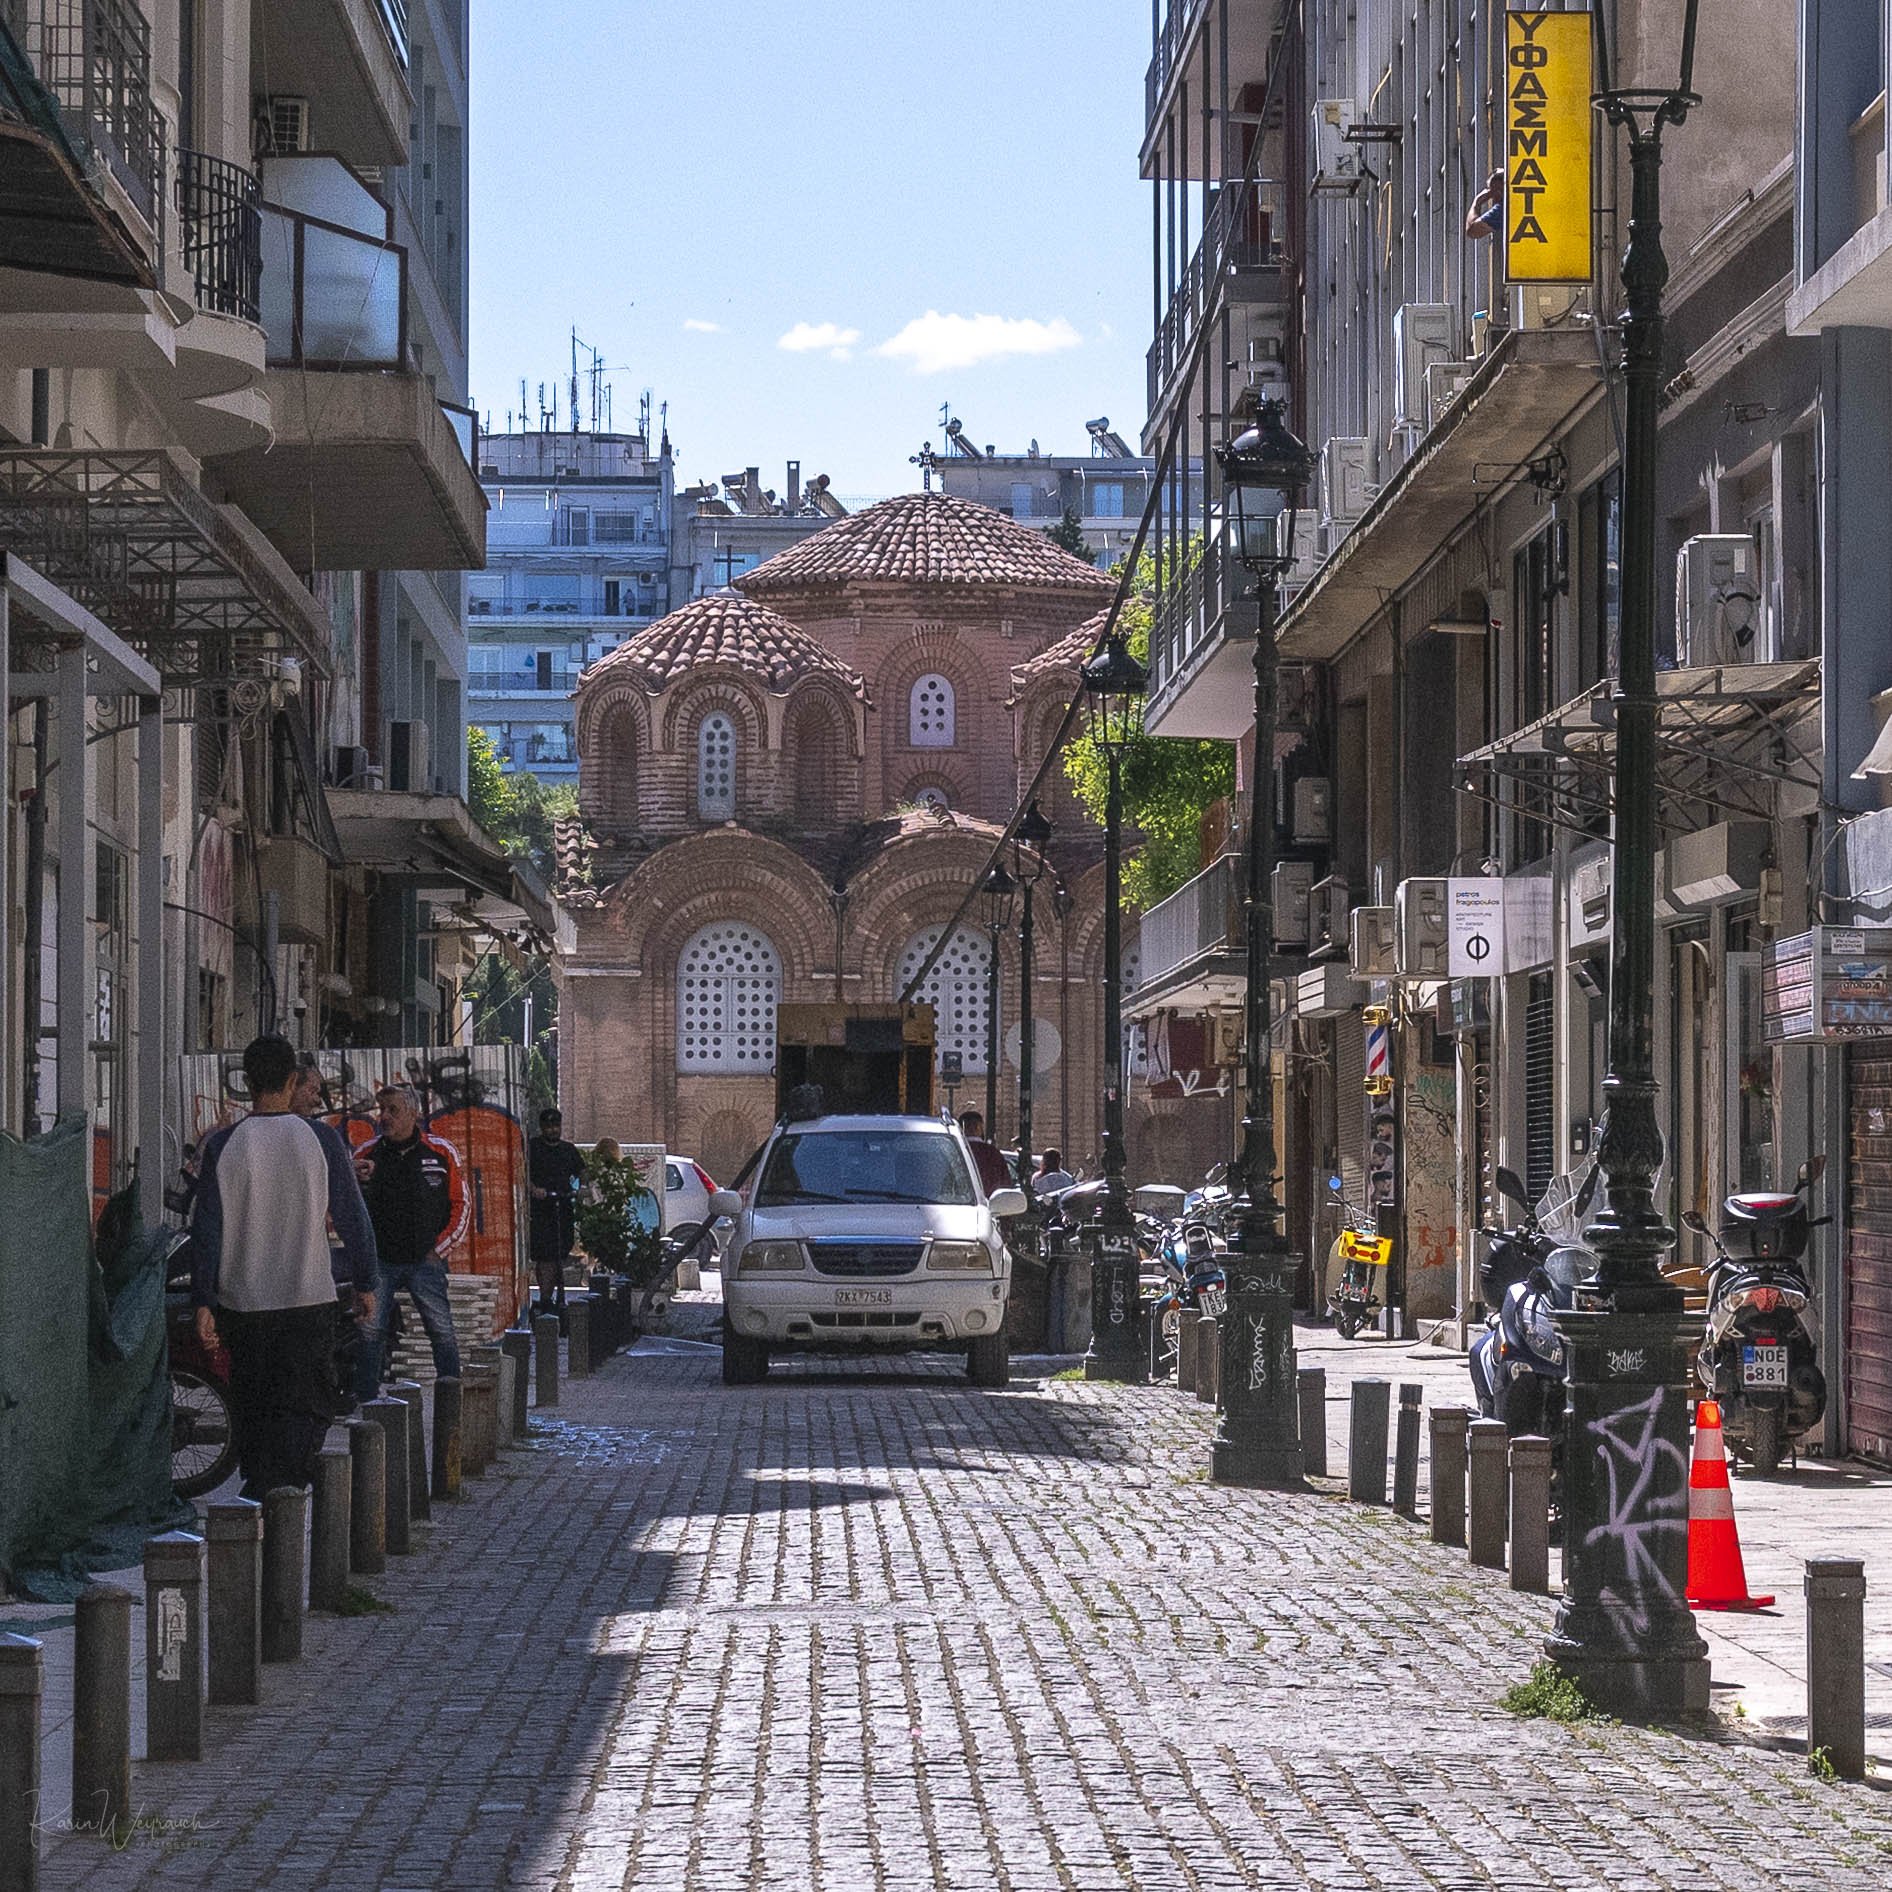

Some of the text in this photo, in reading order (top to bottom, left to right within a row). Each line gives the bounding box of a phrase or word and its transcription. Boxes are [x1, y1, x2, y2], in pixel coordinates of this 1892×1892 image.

[1509, 14, 1548, 243] ΥΦΑΣΜΑΤΑ
[1755, 1350, 1785, 1362] NOE
[1755, 1367, 1785, 1382] 881
